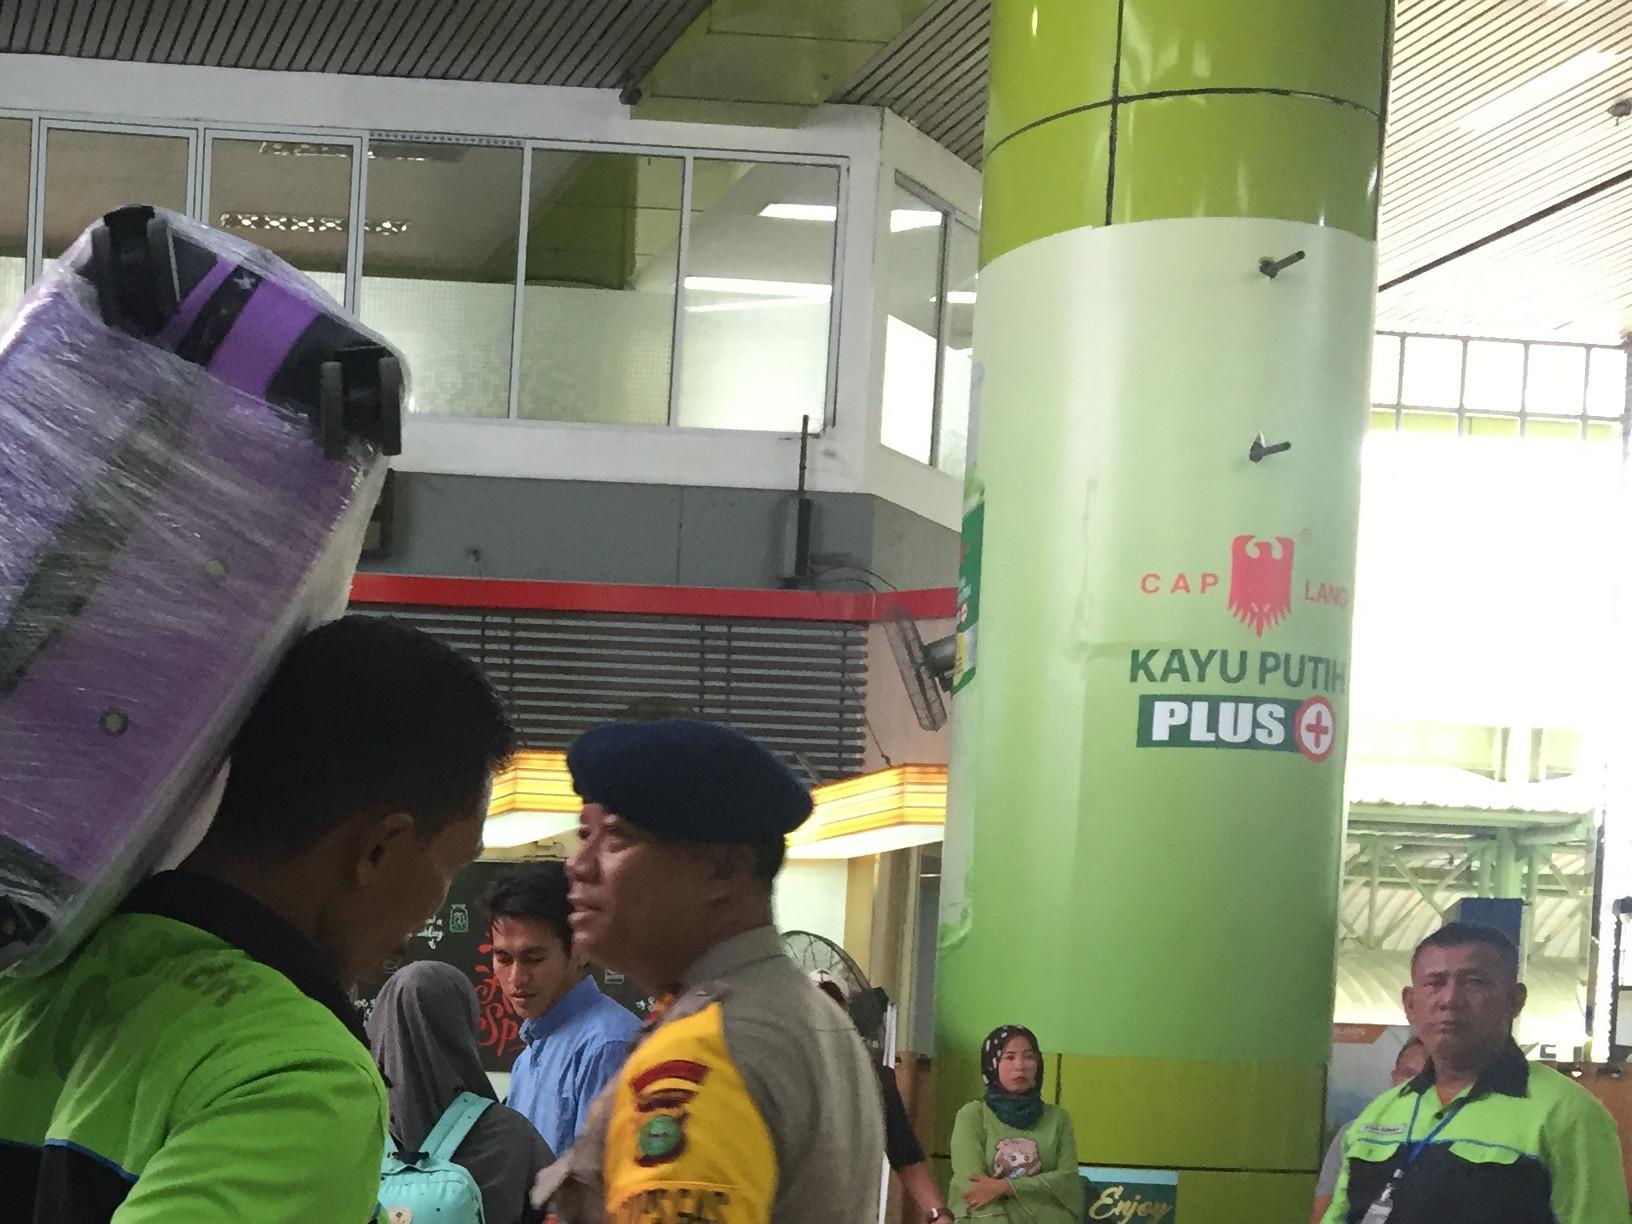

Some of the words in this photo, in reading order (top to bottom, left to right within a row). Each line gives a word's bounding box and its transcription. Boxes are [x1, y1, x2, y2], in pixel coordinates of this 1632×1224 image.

[1140, 572, 1219, 595] CAP
[1129, 647, 1248, 685] KAYU
[1258, 649, 1347, 695] PUTIH
[1151, 699, 1286, 746] PLUS
